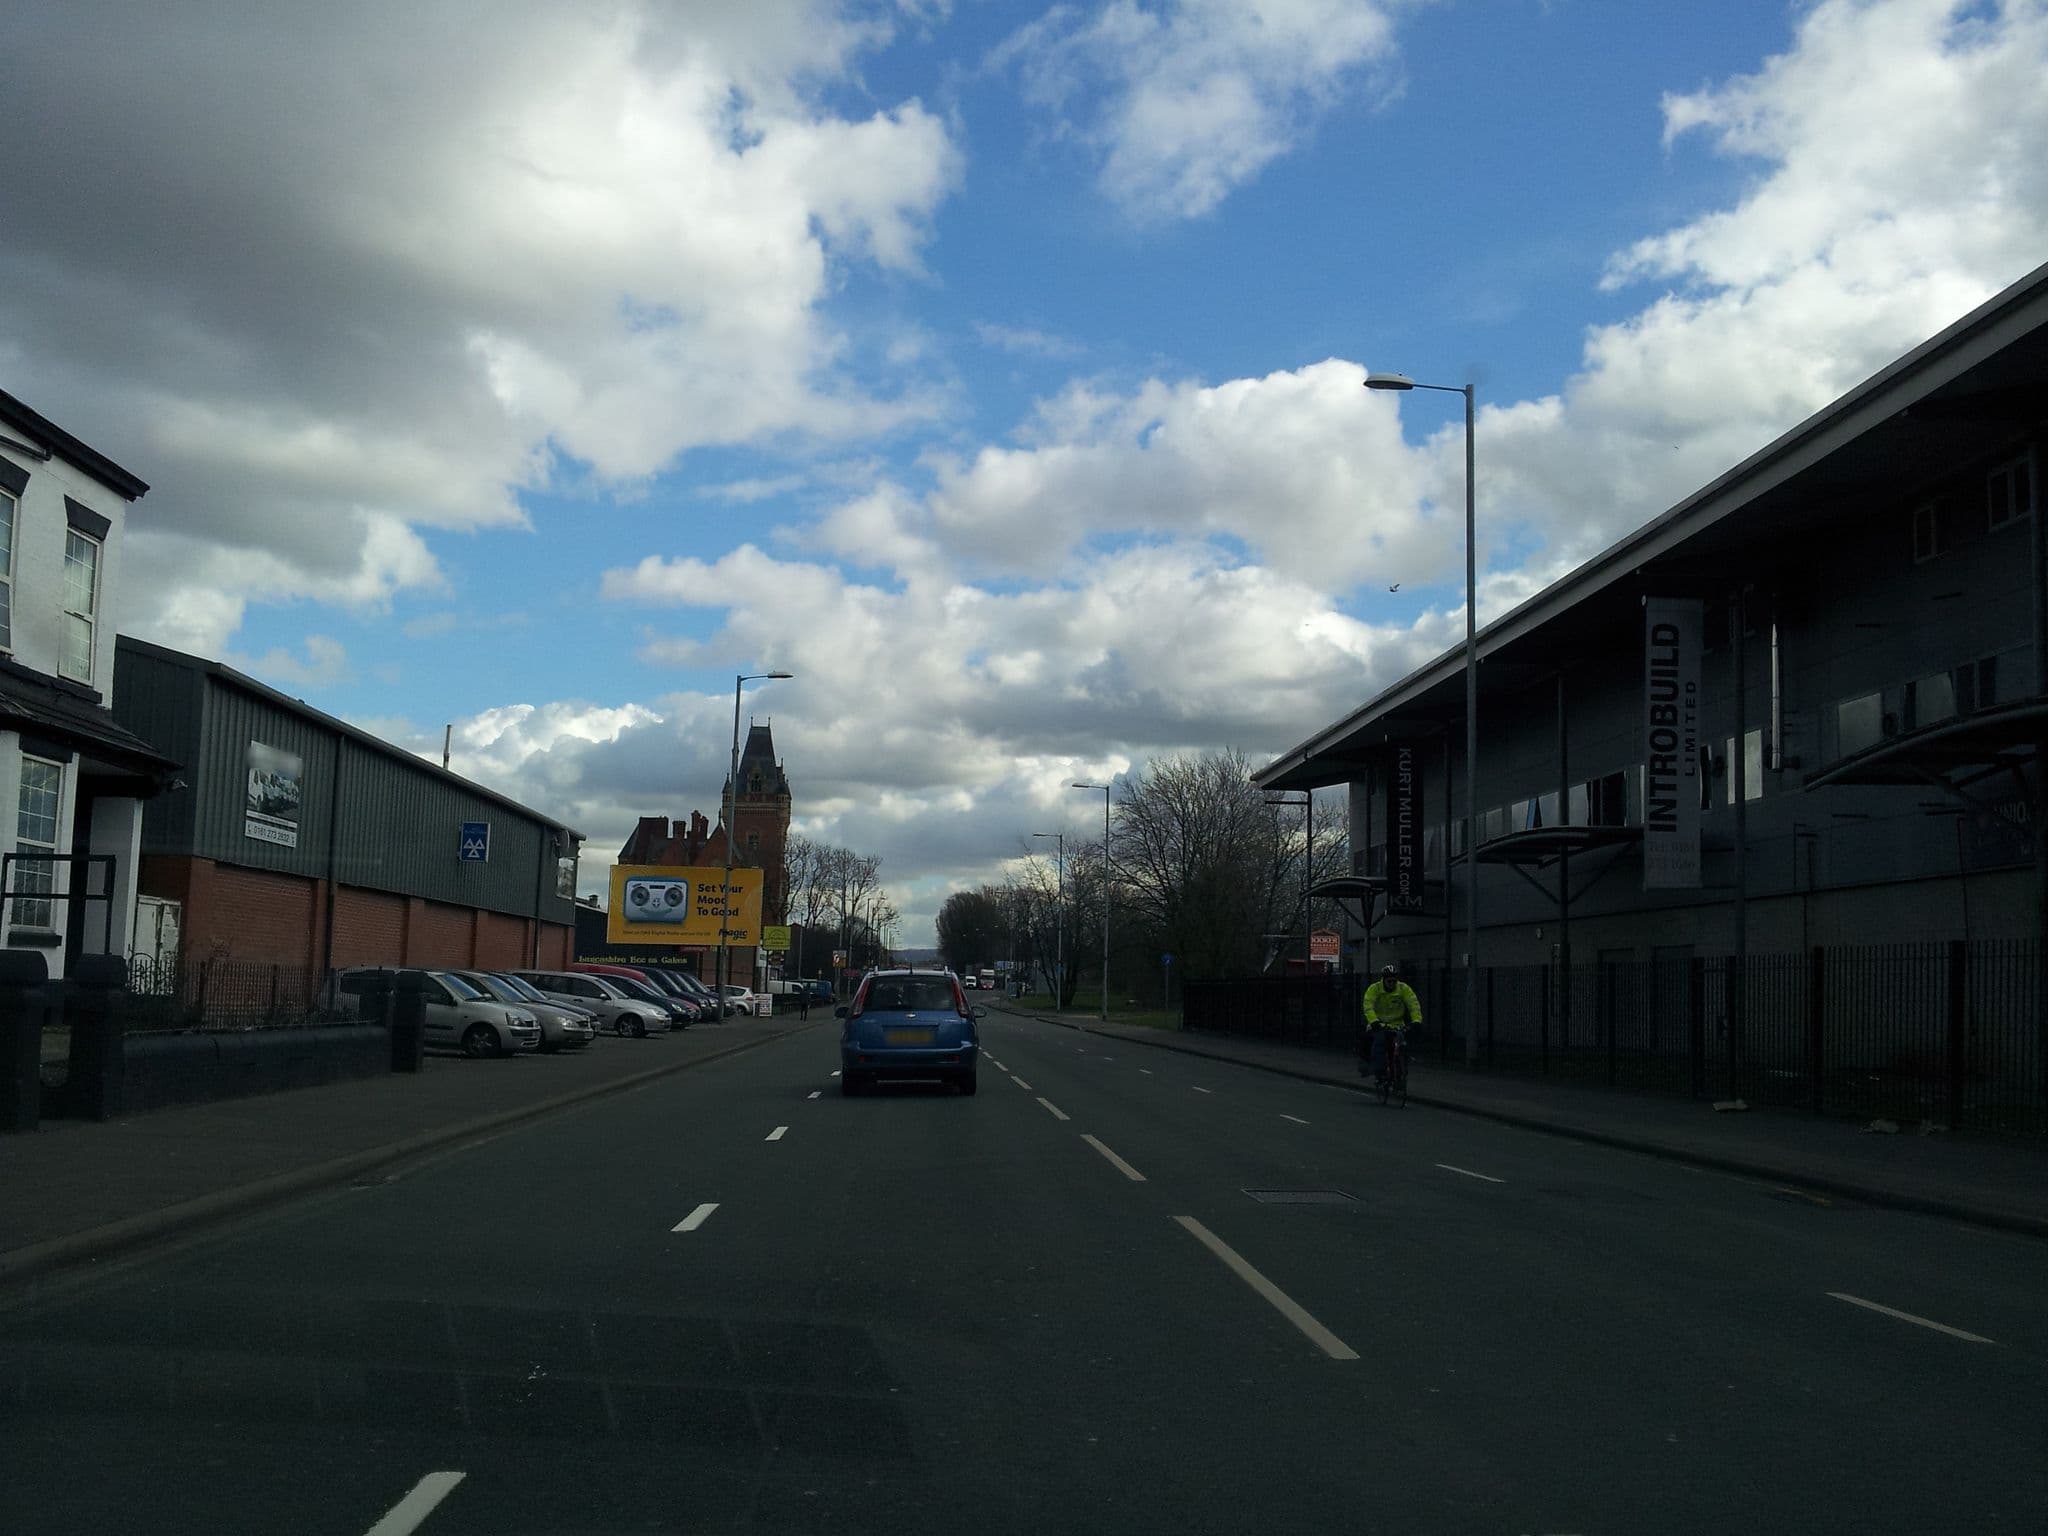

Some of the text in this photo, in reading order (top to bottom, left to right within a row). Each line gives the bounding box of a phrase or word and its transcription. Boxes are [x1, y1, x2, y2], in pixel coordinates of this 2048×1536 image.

[1648, 623, 1681, 833] INTROBUILD
[1684, 681, 1696, 777] LIMITED
[1399, 748, 1412, 795] KURT
[697, 906, 739, 916] To Good
[698, 883, 717, 893] Set
